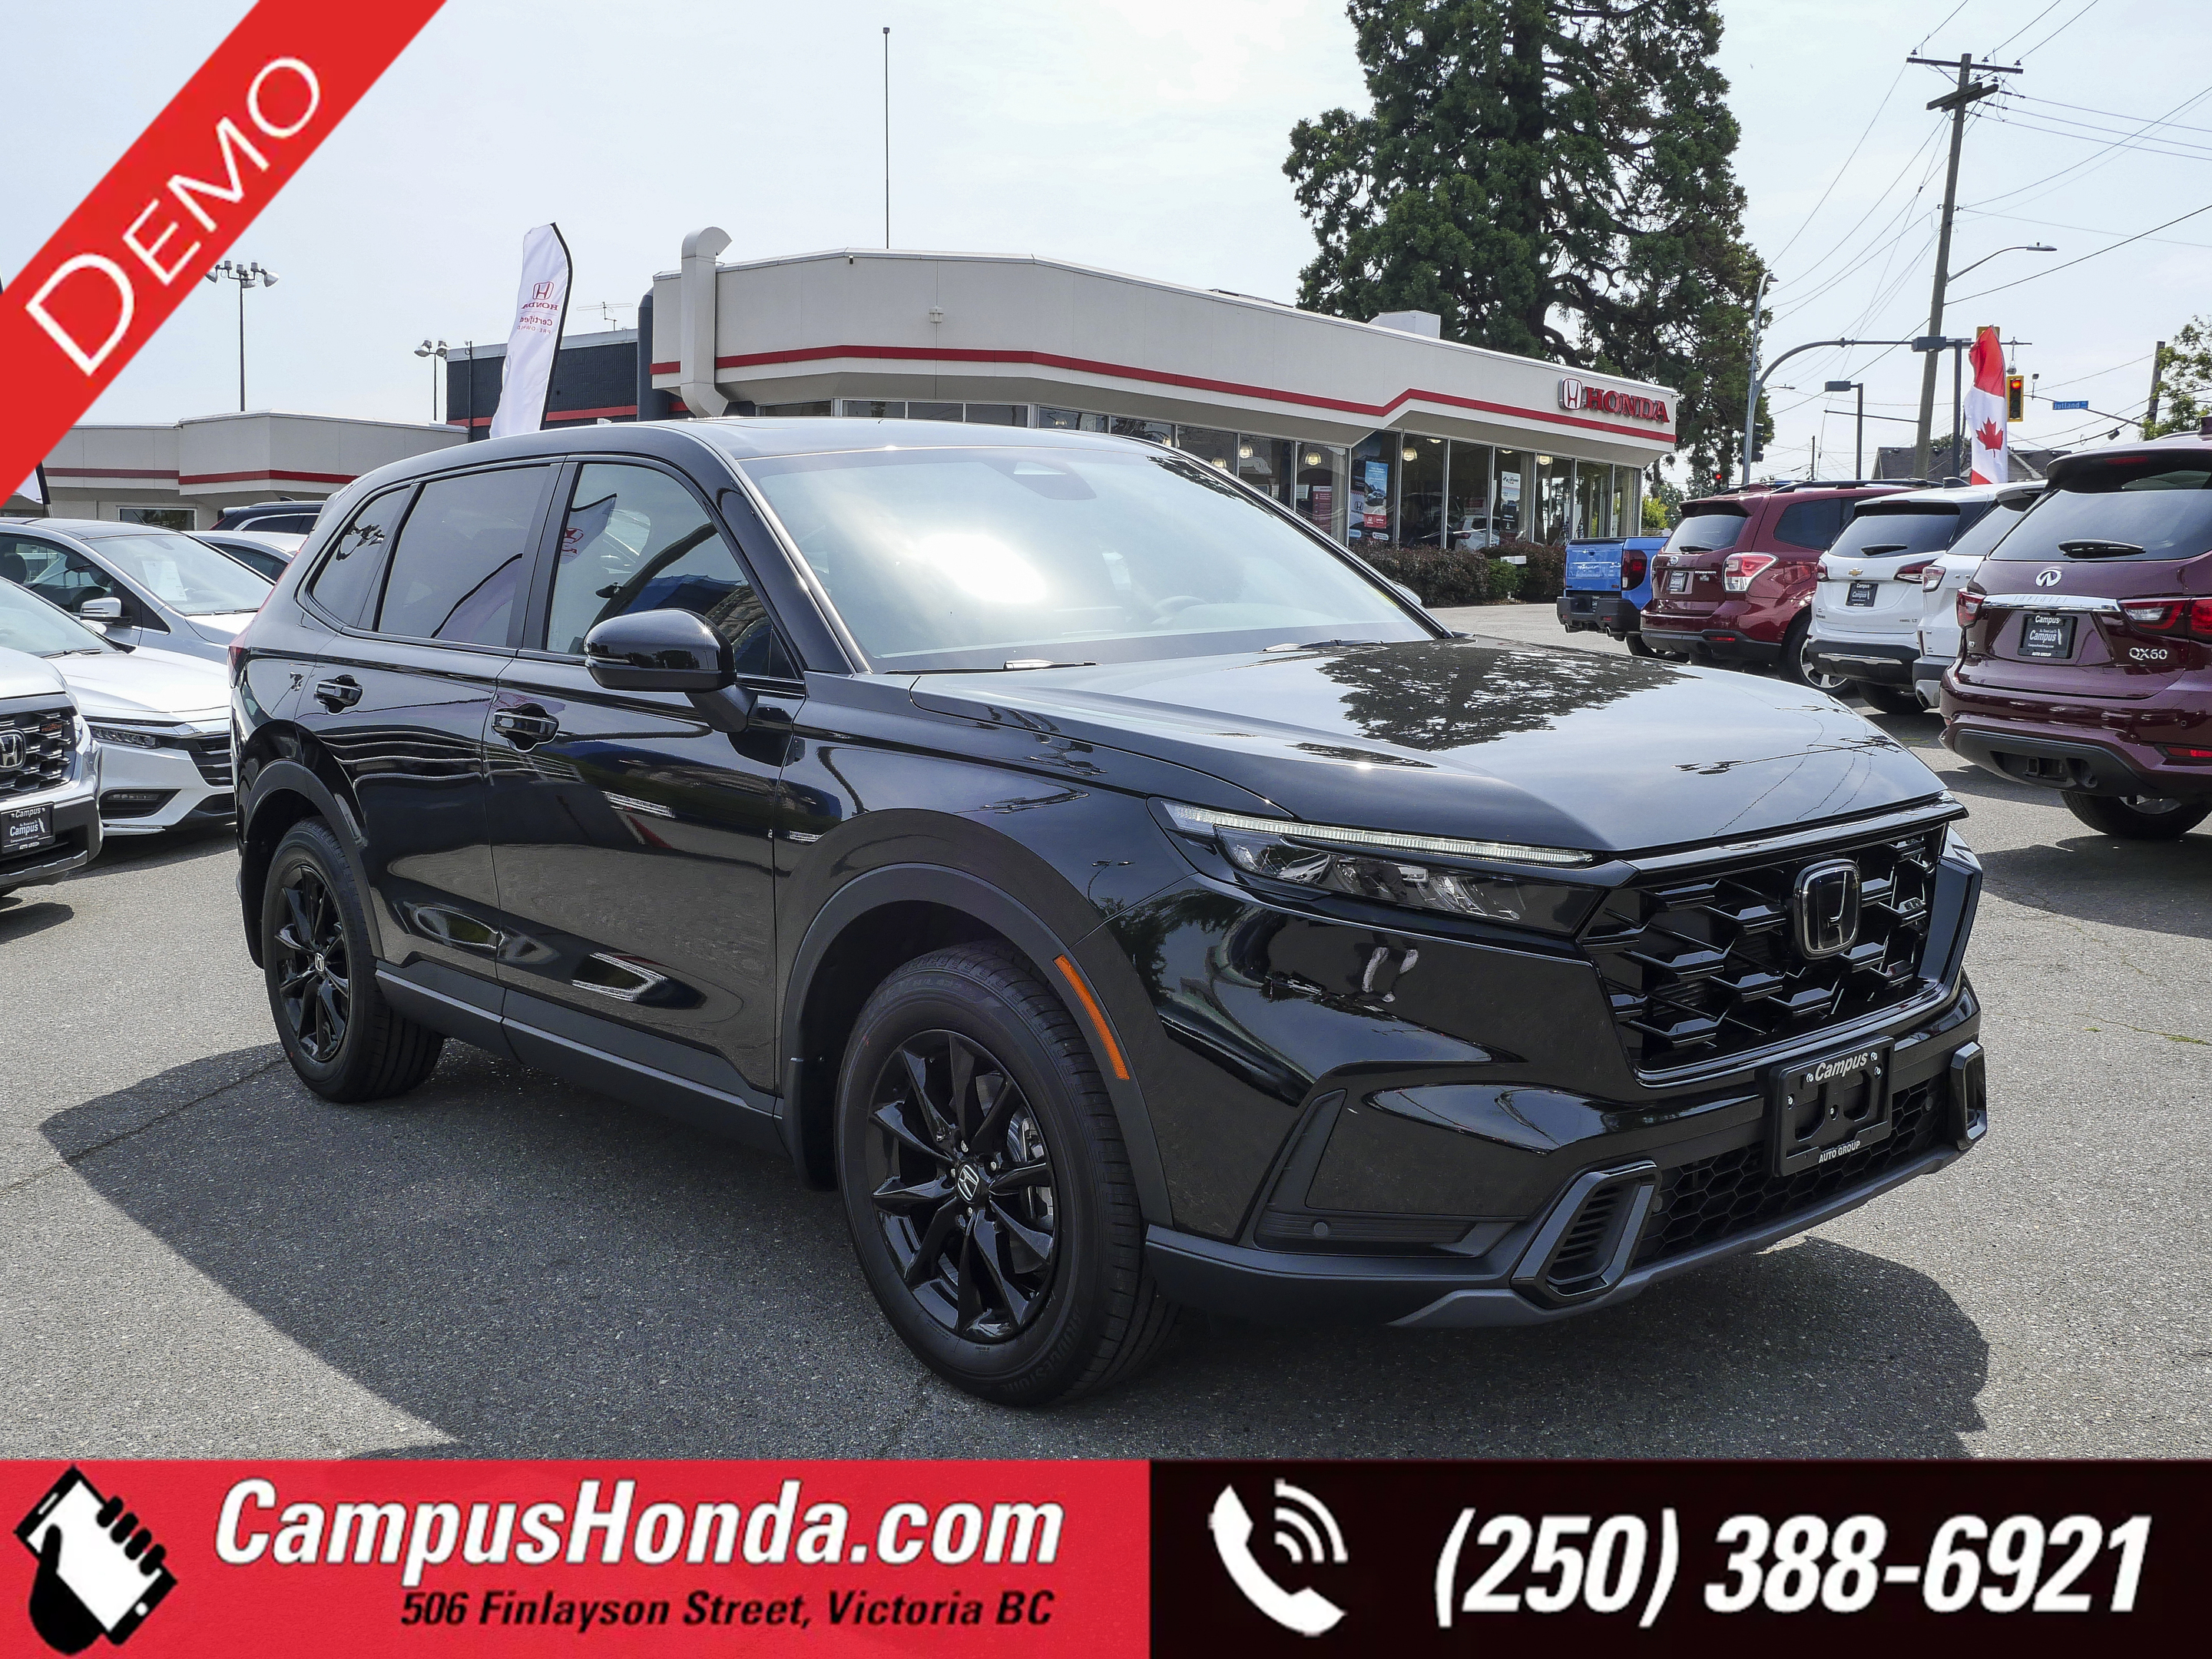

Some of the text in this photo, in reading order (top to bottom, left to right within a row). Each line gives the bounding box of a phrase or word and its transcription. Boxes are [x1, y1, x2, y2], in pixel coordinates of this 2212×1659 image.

[1585, 386, 1671, 423] HONDA
[2035, 615, 2060, 625] Campus
[2029, 629, 2057, 644] Campus
[2129, 647, 2167, 661] QX60
[15, 807, 41, 818] Campus
[10, 823, 38, 836] Campus
[1815, 1052, 1869, 1081] Campus
[1819, 1141, 1861, 1164] AUTO GROUP
